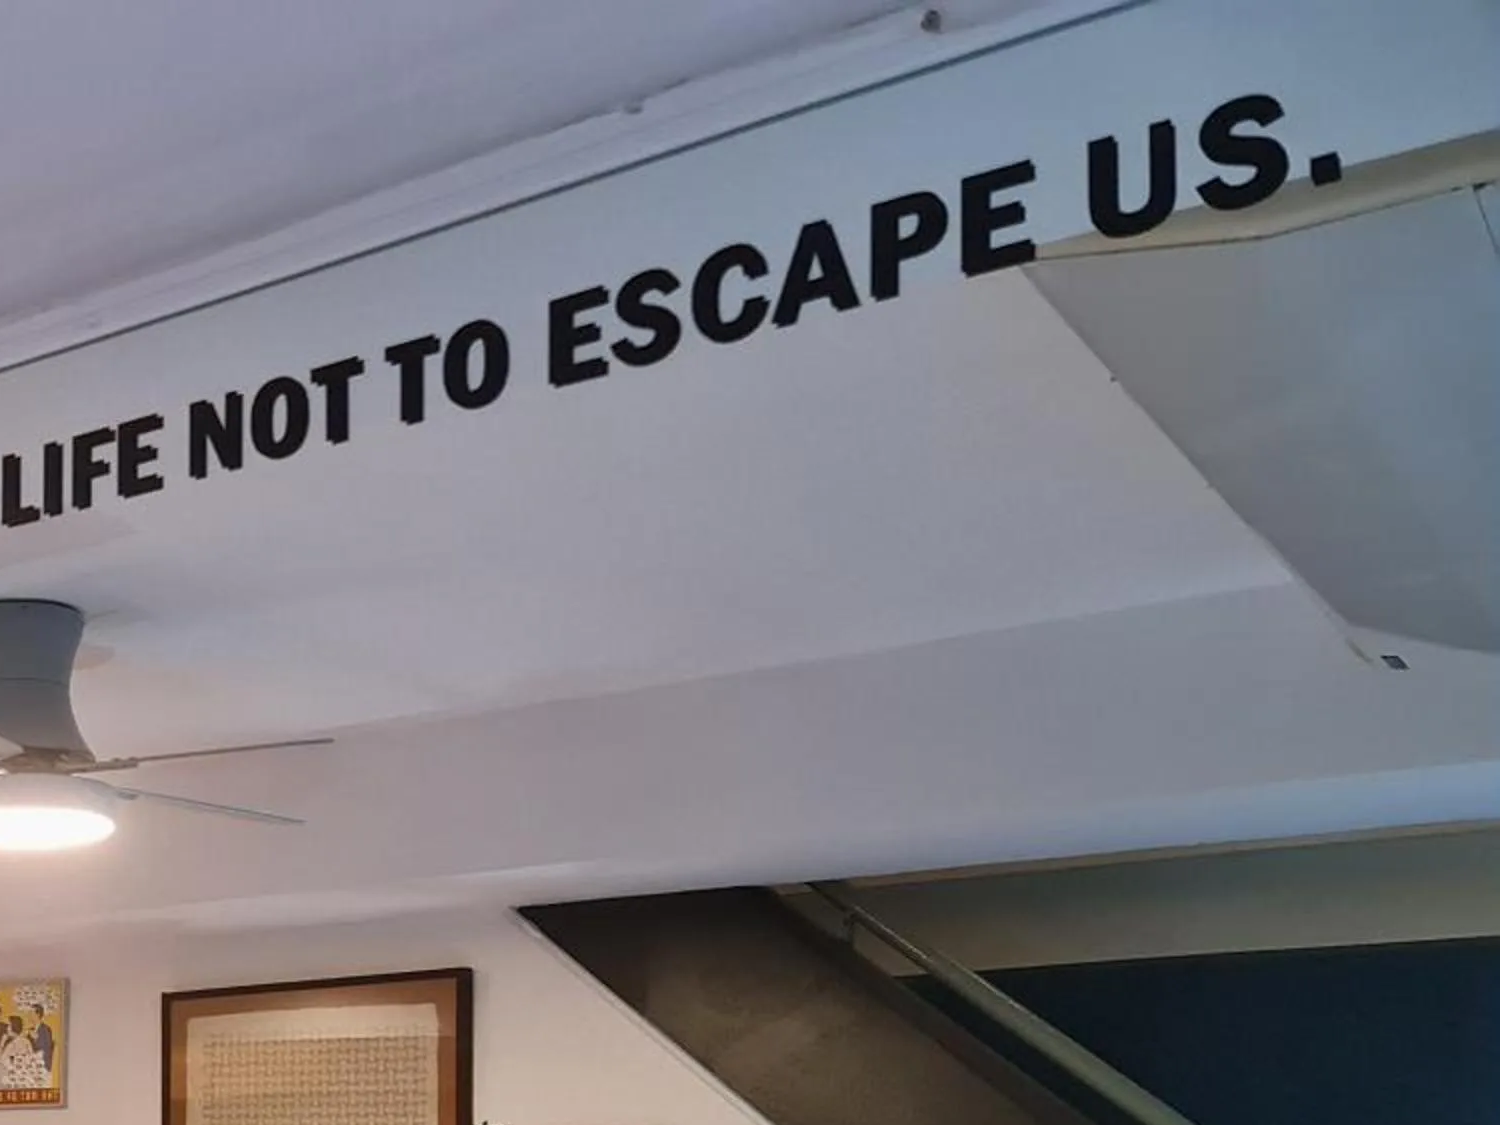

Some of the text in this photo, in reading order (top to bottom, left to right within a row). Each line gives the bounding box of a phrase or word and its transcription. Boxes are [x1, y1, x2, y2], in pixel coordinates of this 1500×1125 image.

[1, 413, 164, 528] LIFE
[189, 355, 365, 480] NOT
[384, 319, 510, 425] TO
[548, 159, 1038, 388] ESCAPE
[1087, 94, 1343, 239] US.
